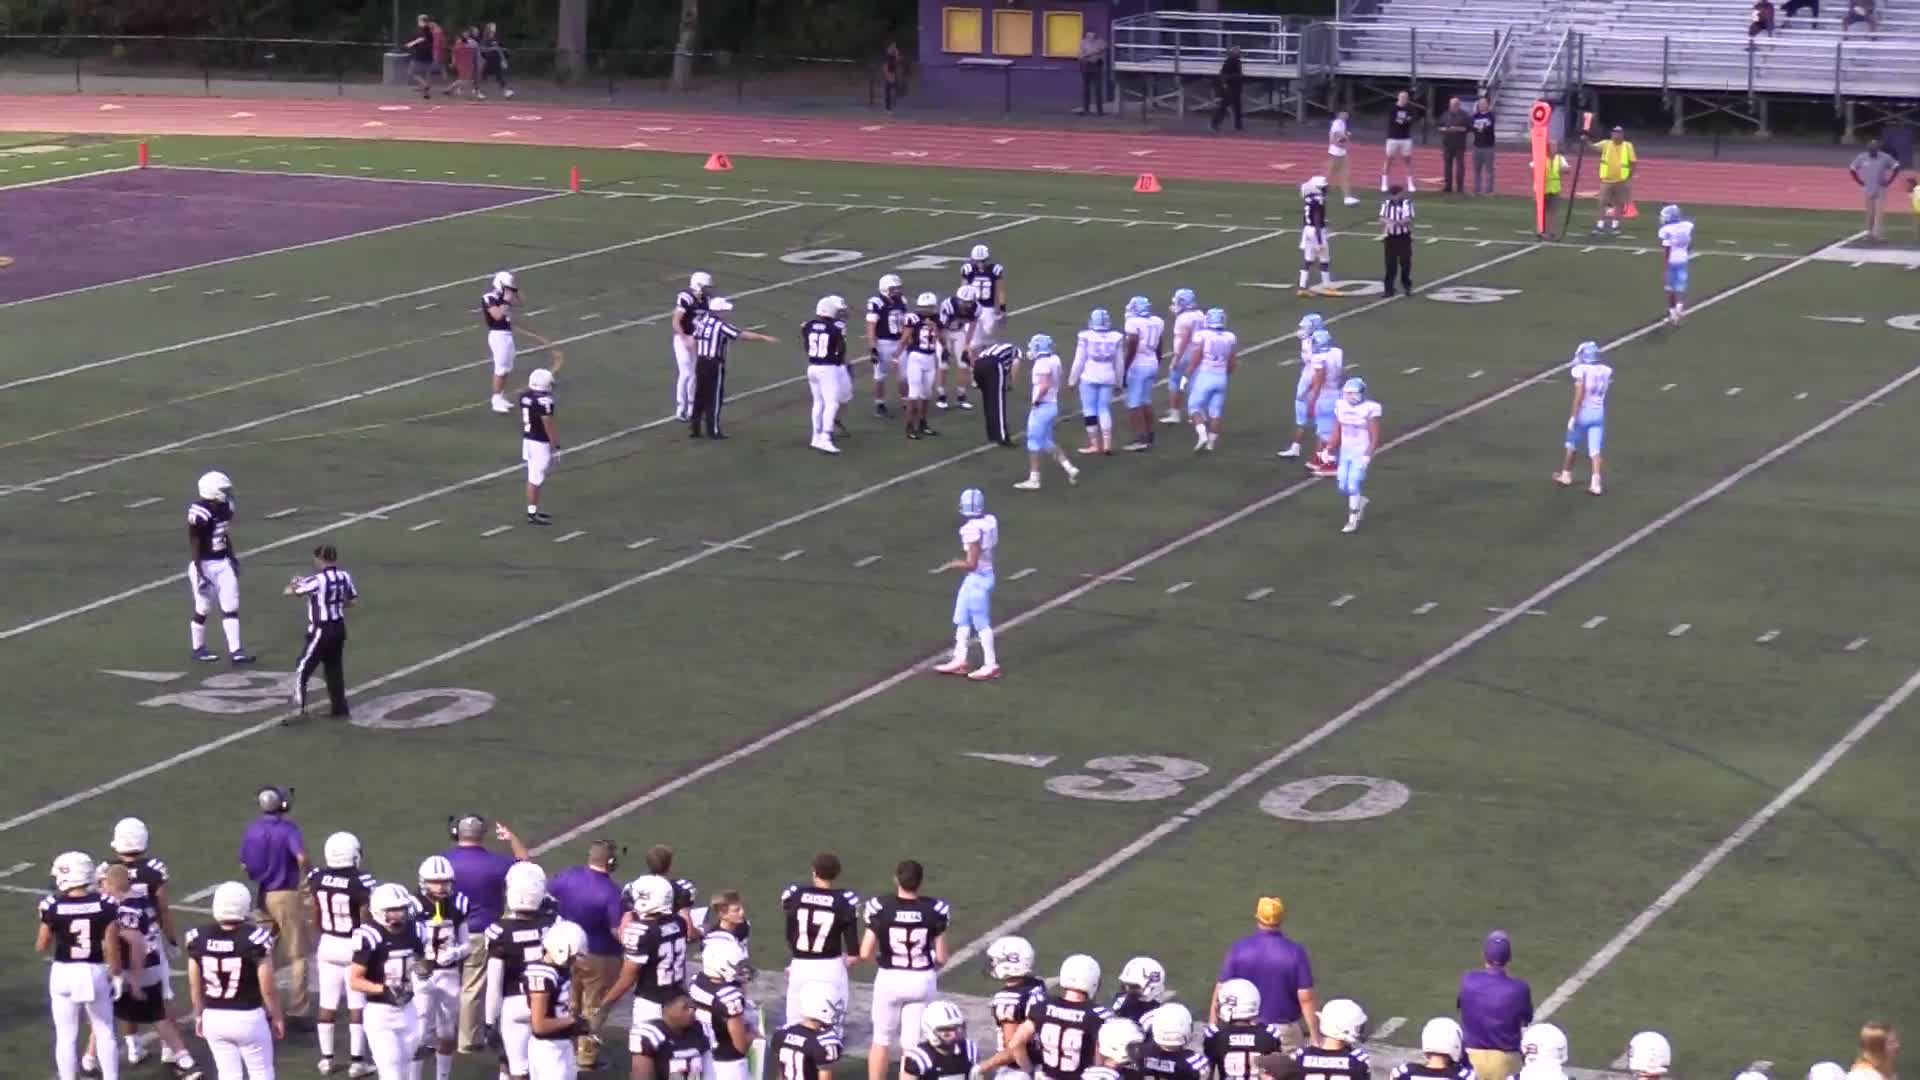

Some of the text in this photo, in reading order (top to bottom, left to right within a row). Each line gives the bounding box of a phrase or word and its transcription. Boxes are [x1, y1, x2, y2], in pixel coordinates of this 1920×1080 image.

[1043, 753, 1411, 823] 30
[69, 919, 91, 958] 3
[796, 908, 835, 952] 17
[889, 927, 930, 968] 52
[202, 955, 242, 999] 57
[1040, 1022, 1085, 1072] 99
